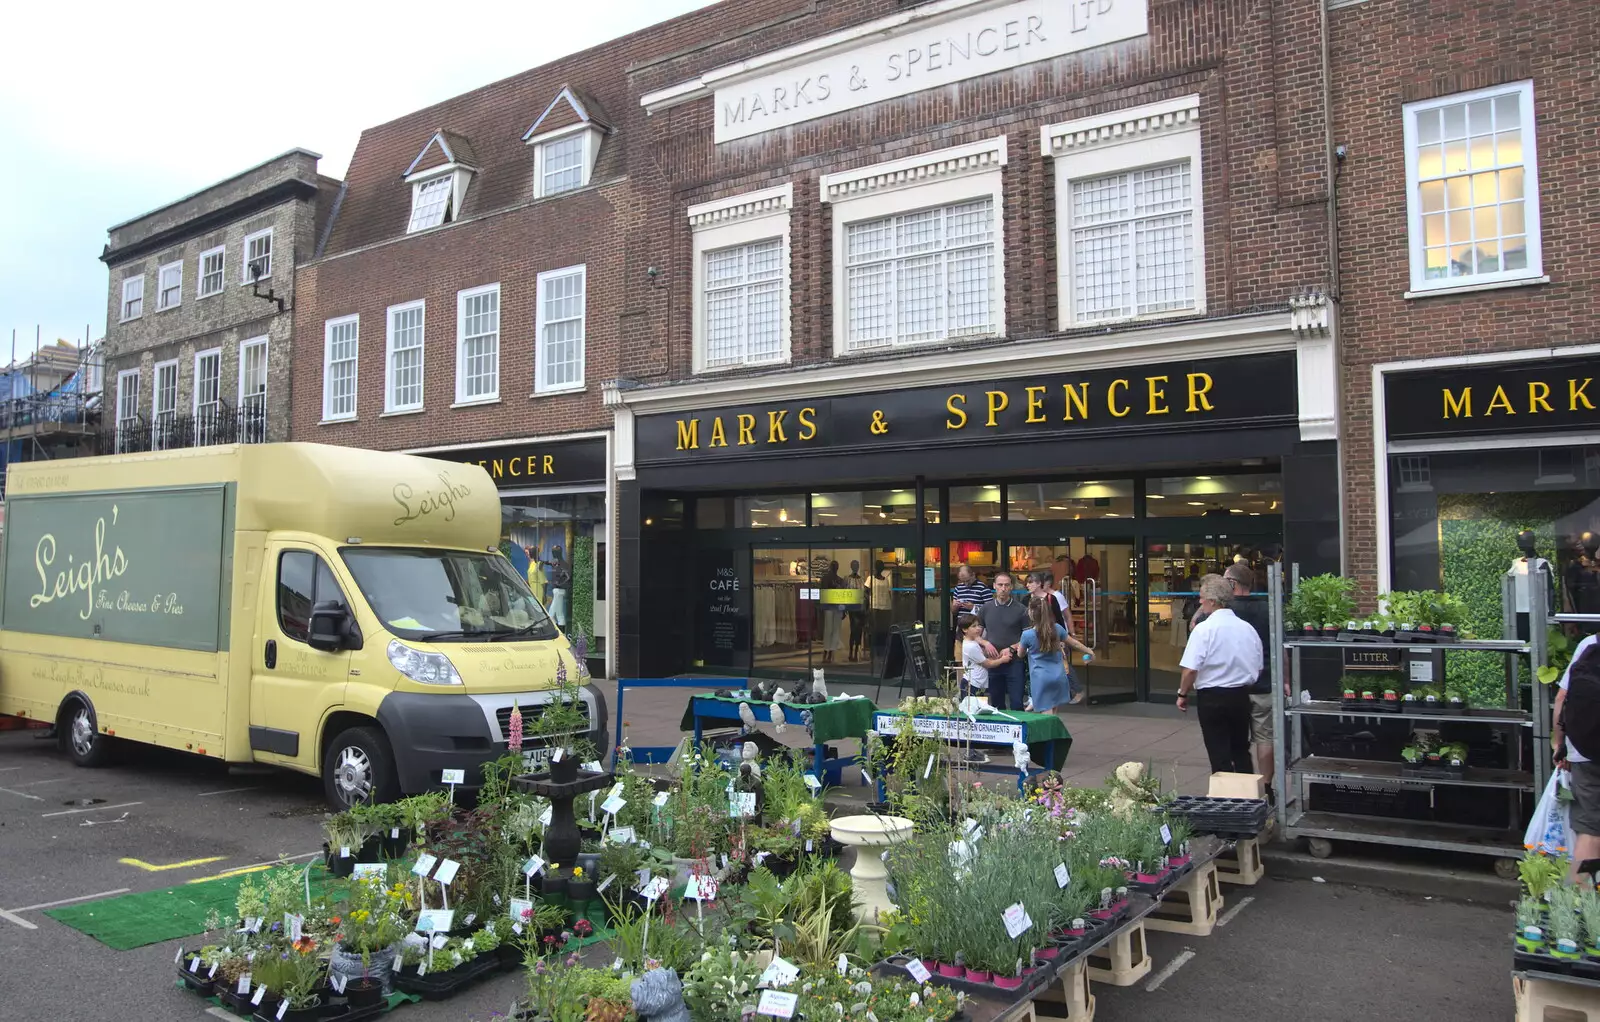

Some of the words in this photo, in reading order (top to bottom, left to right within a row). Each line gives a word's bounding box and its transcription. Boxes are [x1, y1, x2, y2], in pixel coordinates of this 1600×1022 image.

[723, 74, 831, 127] MARKS
[849, 64, 867, 92] &
[886, 14, 1047, 82] SPENCER
[1070, 0, 1113, 34] LTD
[675, 406, 818, 451] MARKS
[870, 409, 889, 435] &
[946, 372, 1215, 430] SPENCER
[1442, 378, 1597, 419] MARK
[463, 455, 555, 479] NCER
[393, 470, 471, 527] Leigh's
[30, 504, 129, 620] Leigh's
[717, 568, 734, 577] M&S
[709, 577, 740, 591] CAFÉ
[95, 589, 114, 609] Fine
[116, 590, 147, 612] Cheeses
[151, 594, 162, 613] &
[163, 592, 184, 615] Pies
[1353, 652, 1389, 662] LITTER
[913, 719, 935, 729] NURSERY
[936, 721, 940, 729] &
[979, 723, 1010, 734] ORNAMENTS
